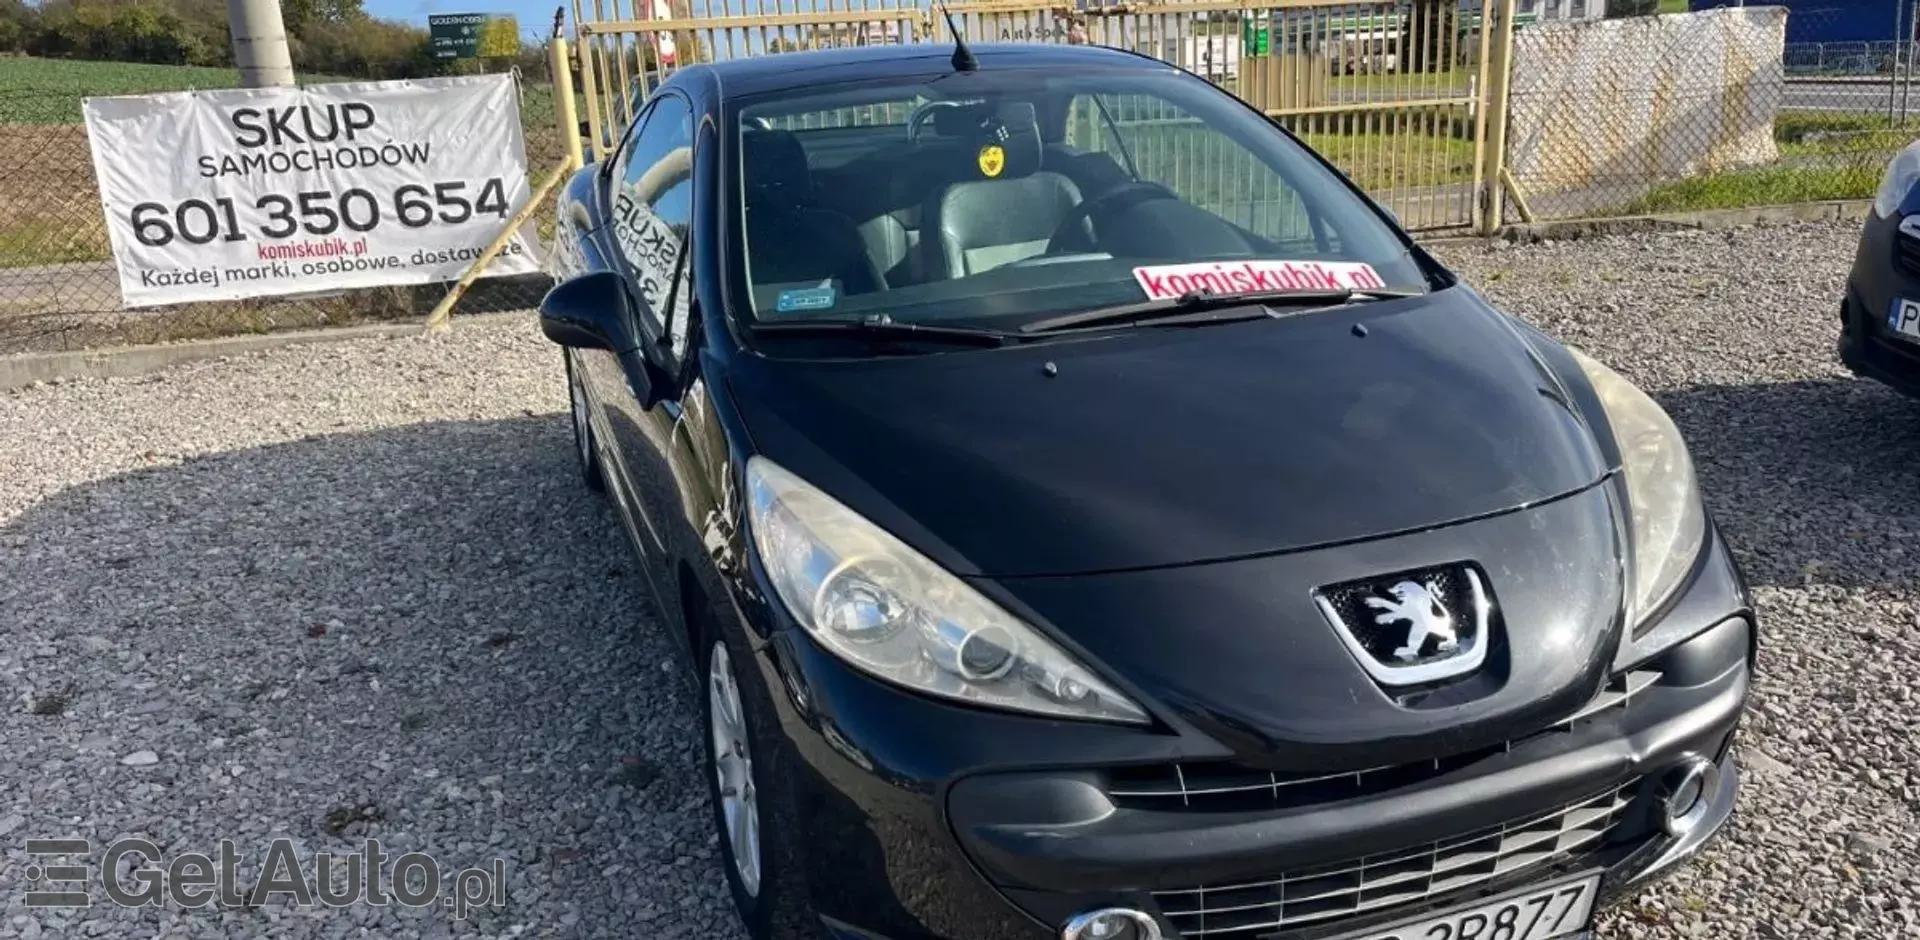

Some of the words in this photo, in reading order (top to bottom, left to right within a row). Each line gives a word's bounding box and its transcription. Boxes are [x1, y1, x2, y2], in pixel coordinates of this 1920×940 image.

[231, 102, 375, 148] SKUP
[198, 139, 430, 178] SAMOCHODÓW
[131, 197, 247, 247] 601
[256, 188, 380, 239] 350
[394, 177, 509, 228] 654
[140, 265, 220, 287] Każdej
[225, 260, 296, 281] marki,
[302, 256, 406, 276] osobowe,
[410, 242, 522, 266] dostawze
[257, 236, 367, 261] komiskubik.pl
[1139, 262, 1380, 297] komiskubikpl
